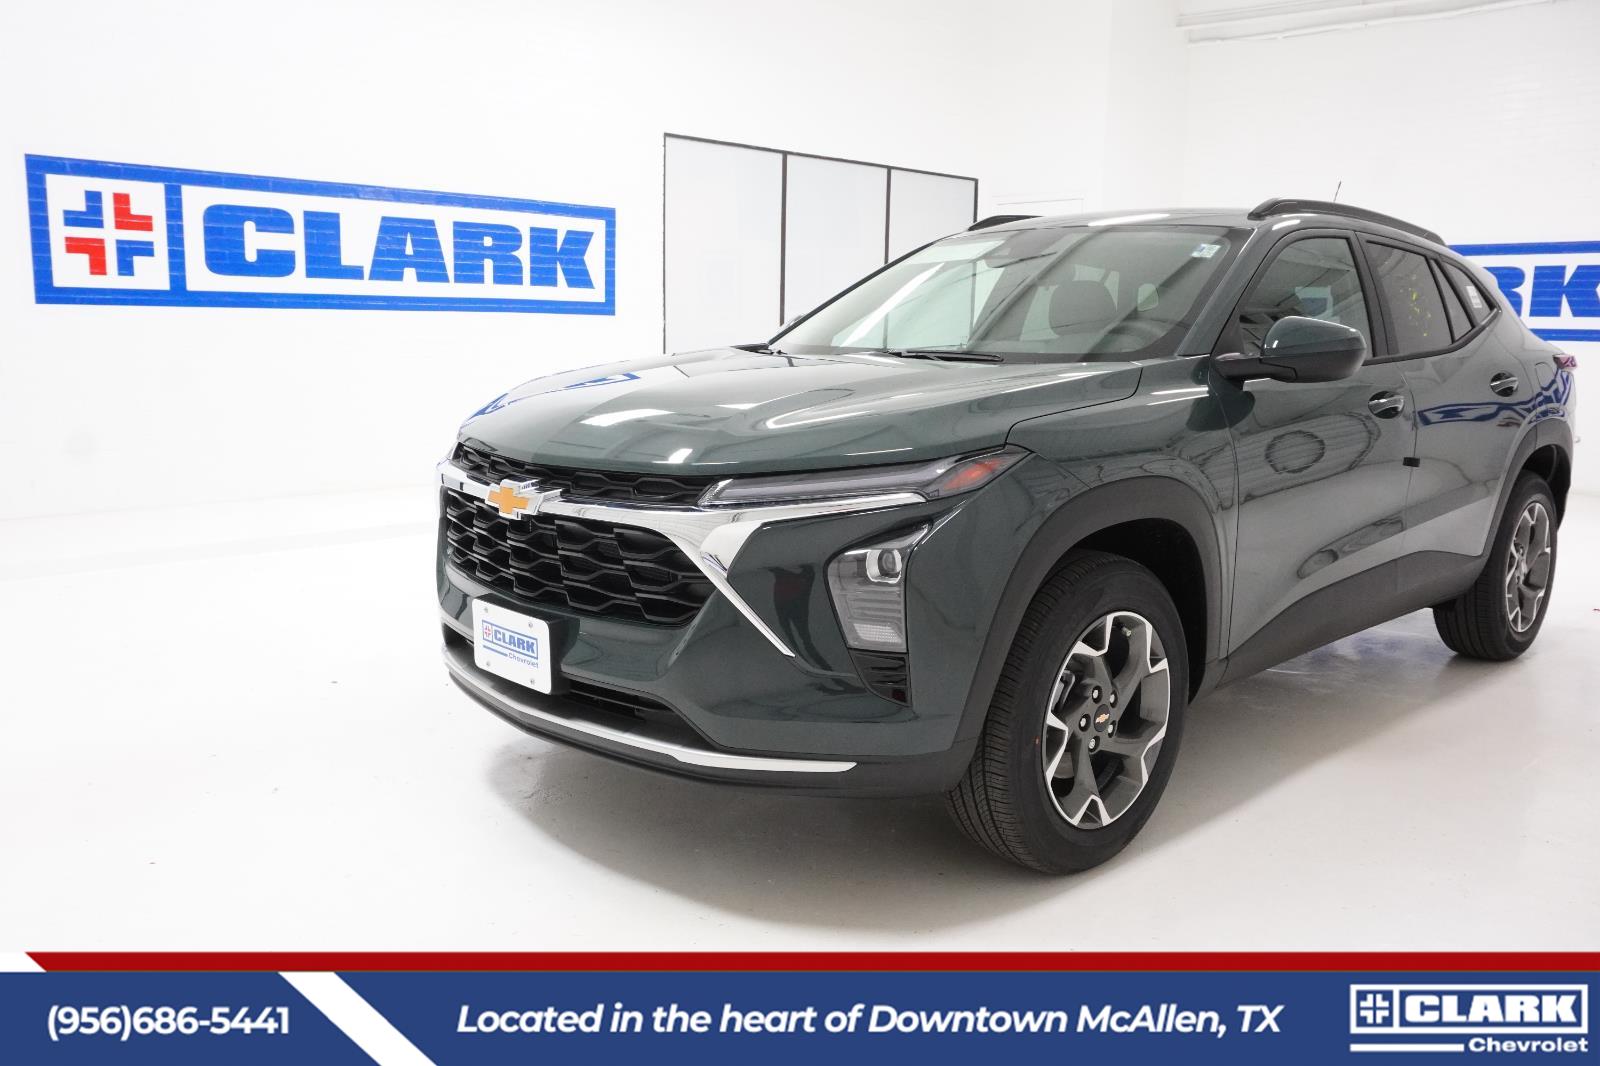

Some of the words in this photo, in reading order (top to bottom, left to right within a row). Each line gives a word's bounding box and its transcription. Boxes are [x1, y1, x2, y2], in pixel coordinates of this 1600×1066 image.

[203, 203, 593, 289] CLARK
[494, 629, 536, 654] CLARK
[508, 652, 539, 669] Chevrolet
